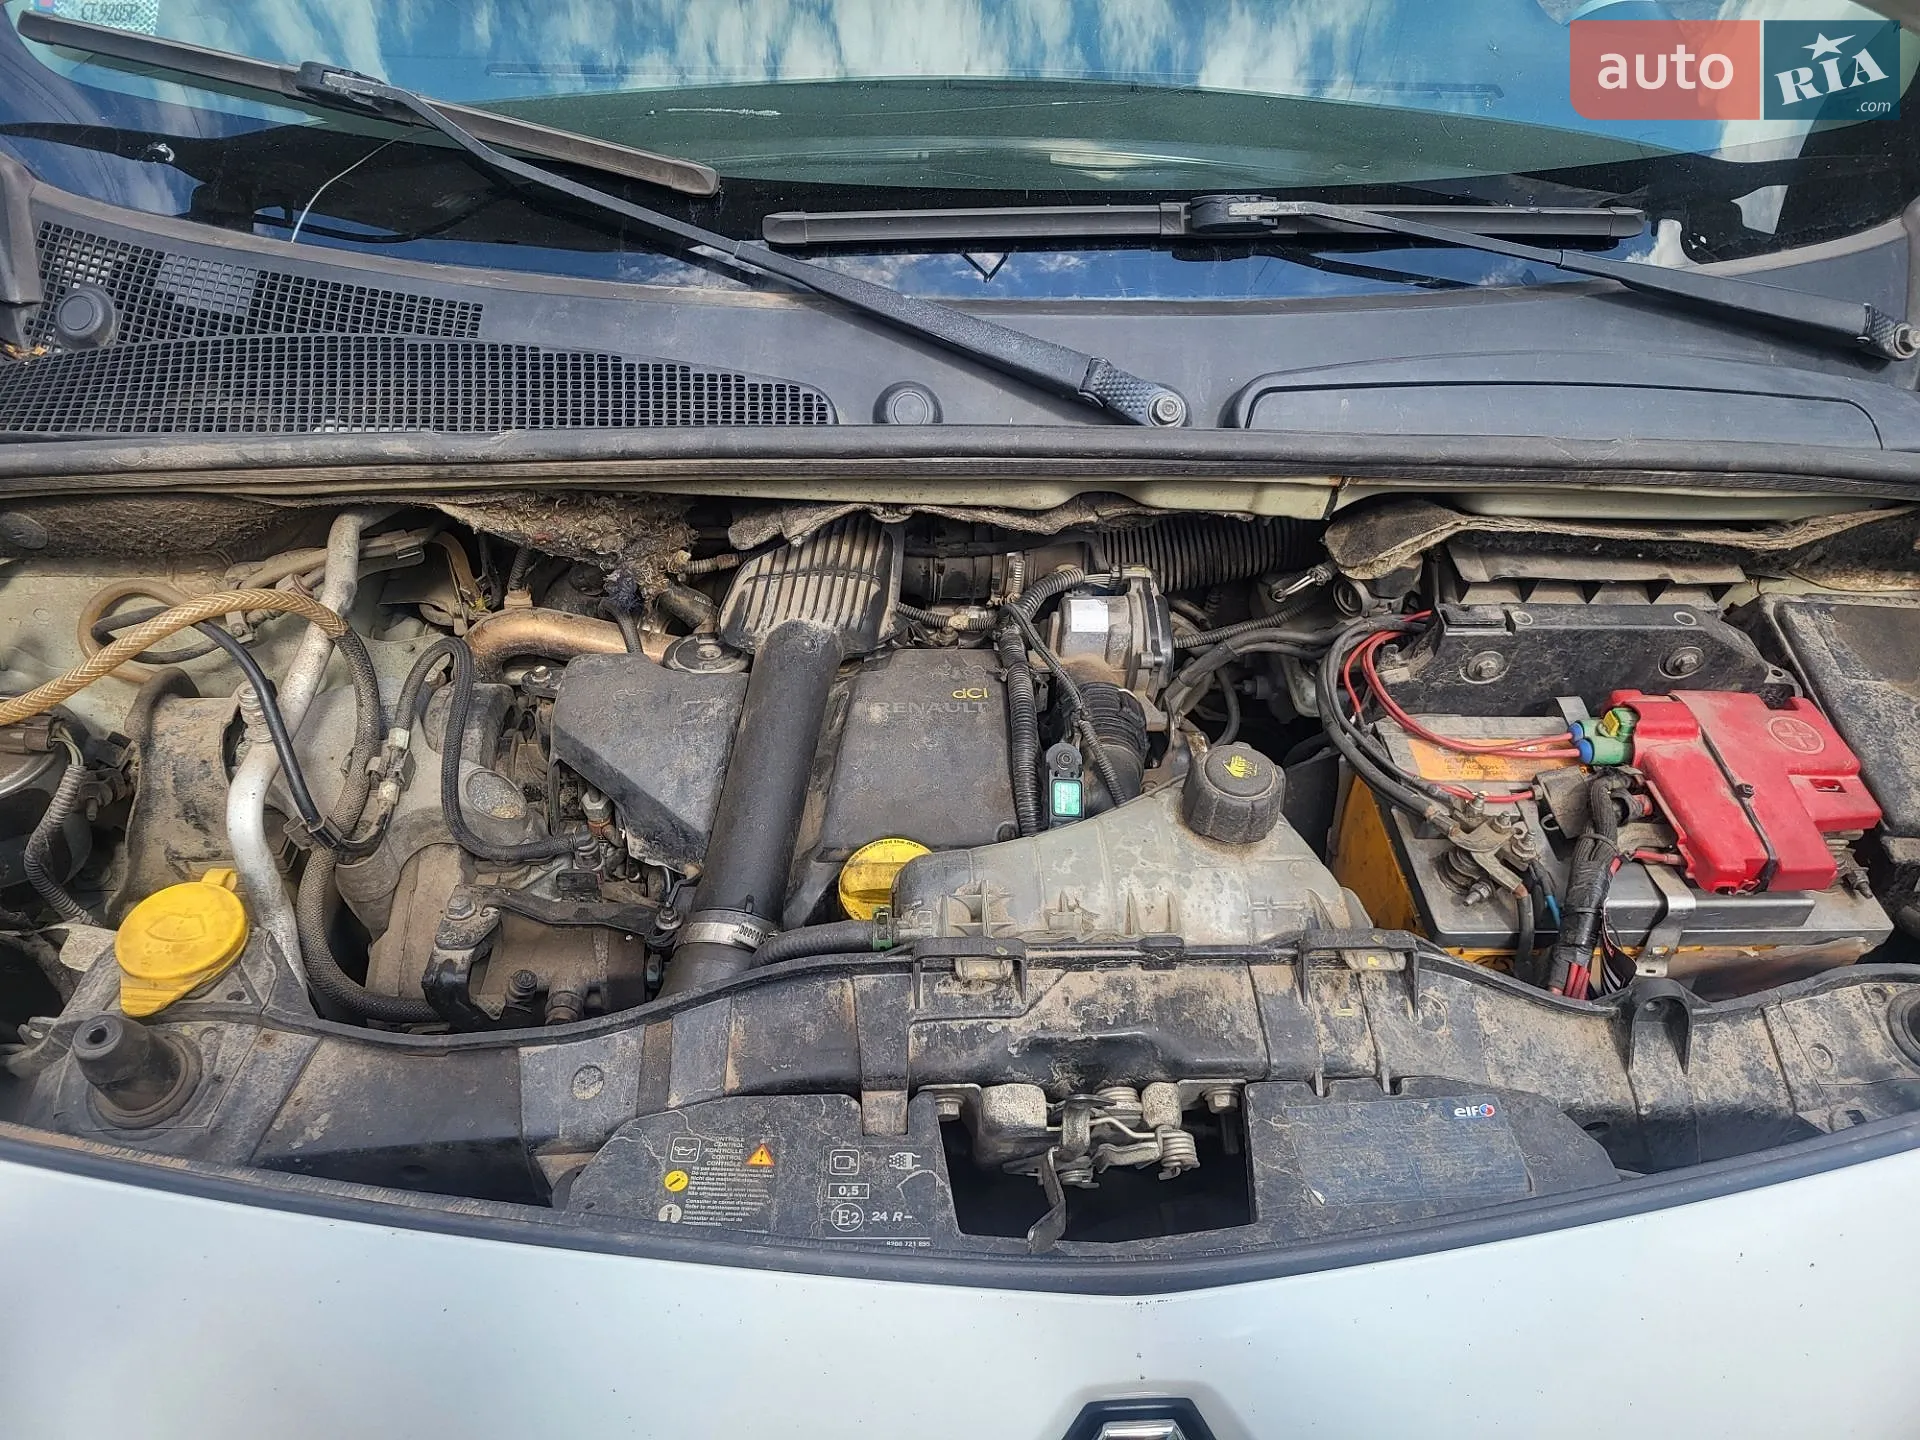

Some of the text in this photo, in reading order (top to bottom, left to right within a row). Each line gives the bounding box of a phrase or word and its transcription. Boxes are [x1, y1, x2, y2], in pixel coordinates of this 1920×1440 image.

[870, 702, 989, 713] RENAULT
[1454, 1105, 1479, 1117] elf
[838, 1186, 859, 1197] 0,5
[836, 1209, 860, 1226] E2
[871, 1211, 888, 1222] 24
